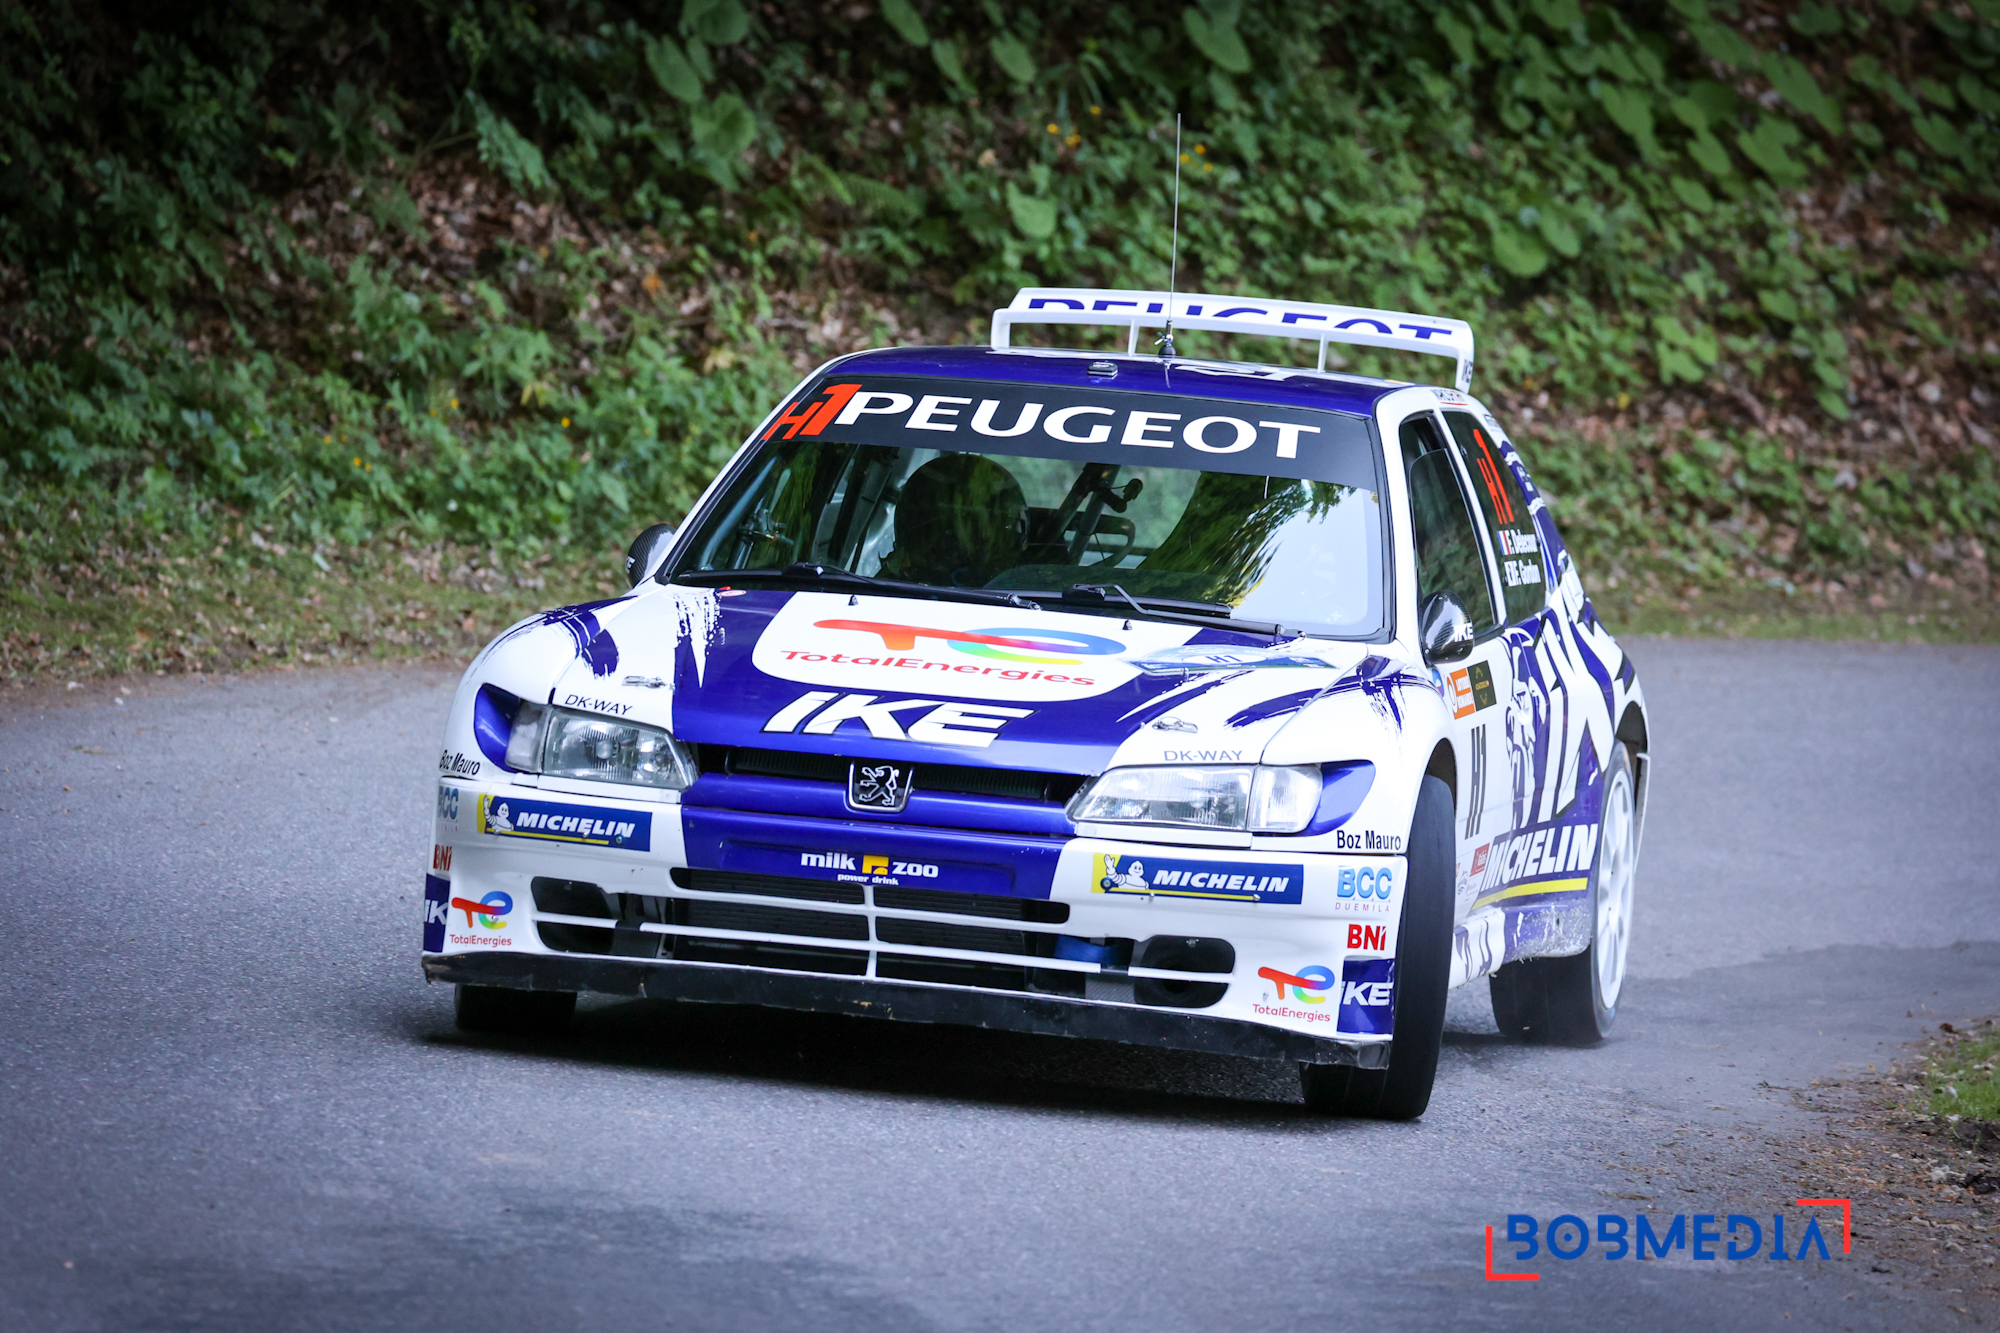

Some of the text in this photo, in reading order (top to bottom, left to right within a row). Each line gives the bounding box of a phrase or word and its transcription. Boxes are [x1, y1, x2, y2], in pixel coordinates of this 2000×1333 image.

[834, 391, 1321, 459] PEUGEOT
[780, 650, 1096, 687] TotalEnergies
[564, 694, 633, 716] DK-WAY
[761, 690, 1038, 749] IKE
[439, 750, 481, 776] Boz Mauro
[1164, 750, 1243, 761] DK-WAY
[516, 811, 636, 838] MICHELIN
[1337, 829, 1402, 851] Boz Mauro
[800, 852, 939, 878] milk zoo
[1480, 823, 1599, 893] MICHELIN
[837, 873, 899, 886] power drink
[1152, 869, 1289, 893] MICHELIN
[1337, 865, 1393, 900] BCC
[1335, 902, 1390, 913] DUEMILA
[450, 934, 512, 948] TotalEnergies
[1253, 1003, 1331, 1023] TotalEnergies
